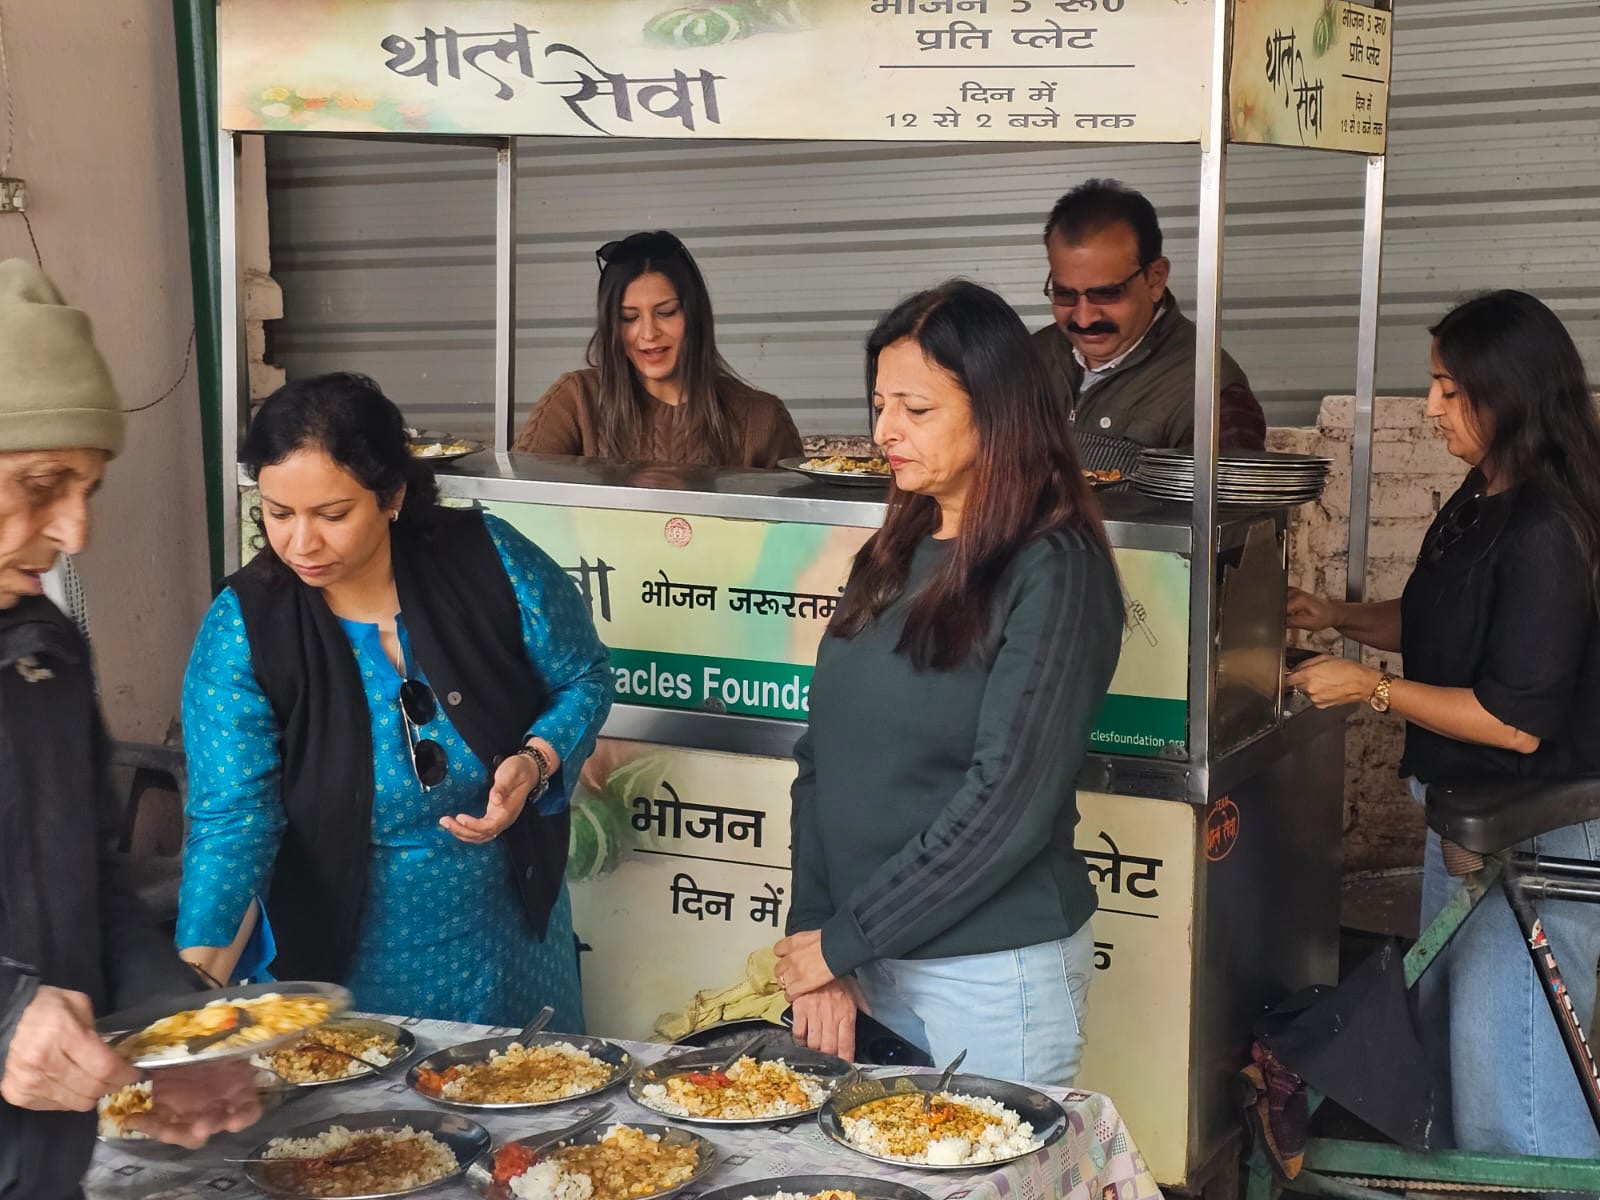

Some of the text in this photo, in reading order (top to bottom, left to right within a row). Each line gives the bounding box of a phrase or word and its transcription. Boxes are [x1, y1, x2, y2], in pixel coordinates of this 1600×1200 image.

[916, 18, 1098, 51] प्रति प्लेट
[1349, 35, 1381, 66] प्रति प्लेट
[536, 42, 729, 136] सेवा
[960, 80, 1058, 104] दिन में
[1293, 49, 1324, 145] सेवा
[885, 106, 1137, 129] 12 से 2 बजे तक
[641, 569, 845, 620] भोजन जरूरतमं
[610, 662, 692, 700] acles
[631, 781, 766, 848] भोजन
[670, 873, 785, 927] दिन में
